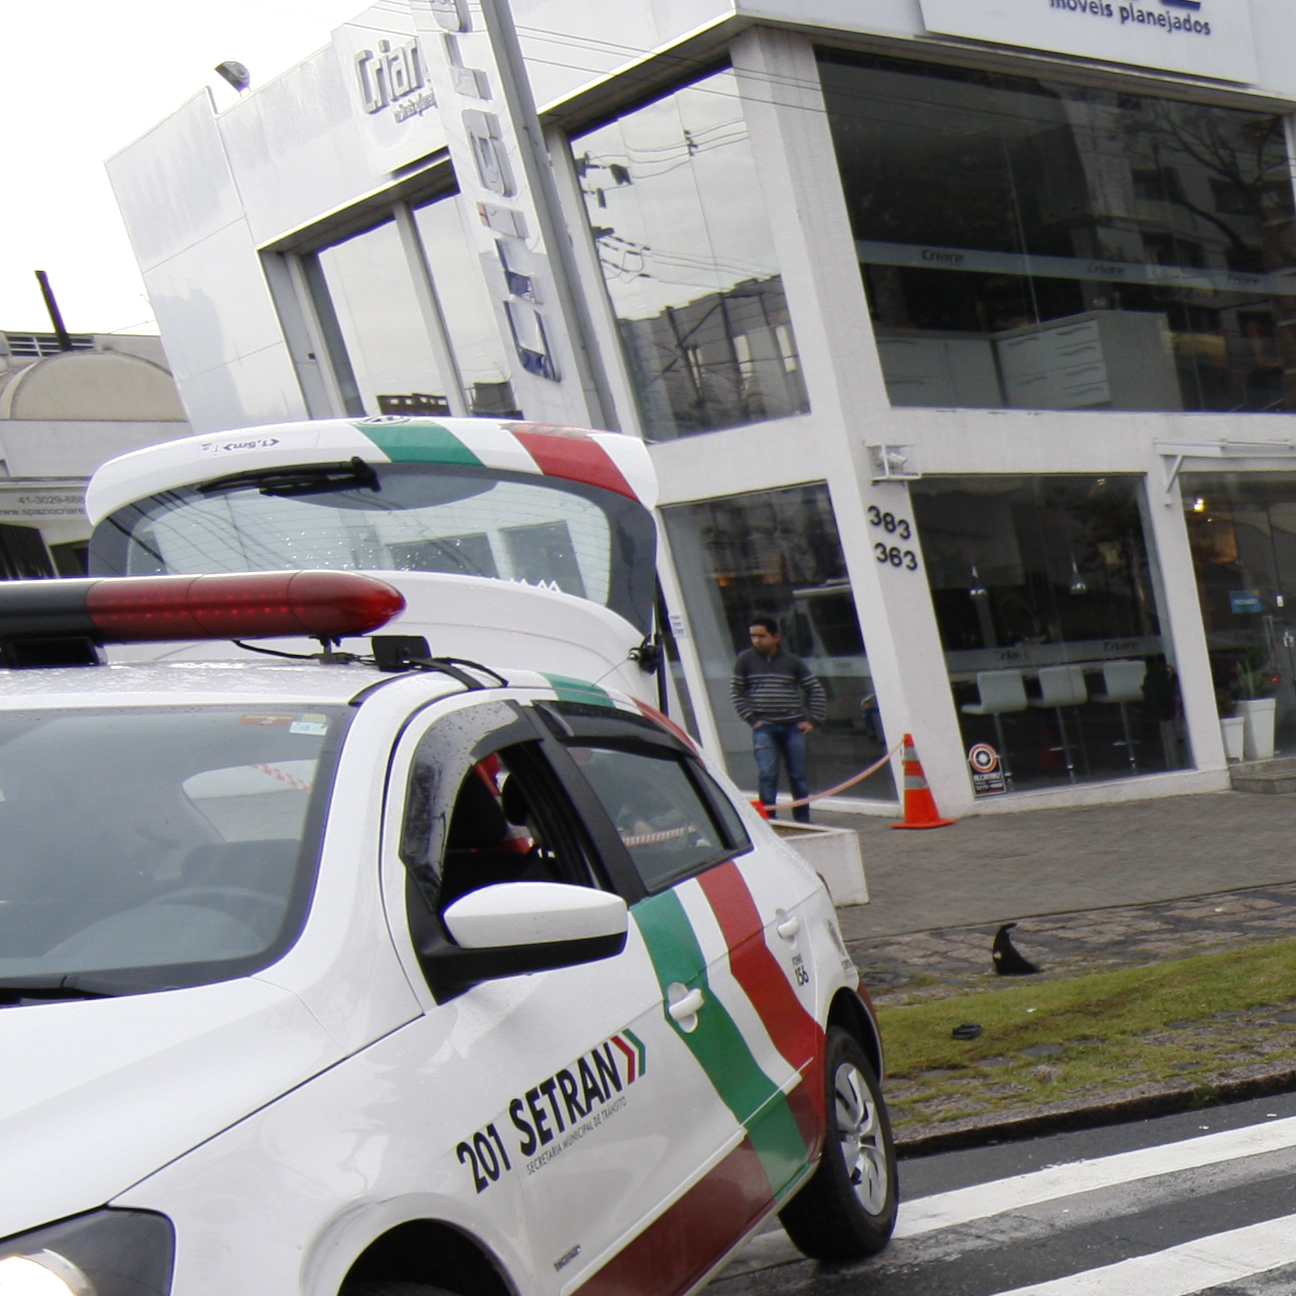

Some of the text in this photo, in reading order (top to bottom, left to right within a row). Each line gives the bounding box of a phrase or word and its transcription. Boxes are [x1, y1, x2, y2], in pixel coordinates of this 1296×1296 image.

[1119, 4, 1211, 36] planejados
[353, 38, 426, 115] Criar
[922, 248, 964, 264] Criare
[867, 505, 911, 540] 383
[874, 542, 918, 571] 363
[794, 964, 810, 987] 156
[455, 1041, 624, 1194] 201 SETRAN
[526, 1143, 562, 1176] SECRETARIA
[561, 1120, 594, 1148] MUNICIPAL
[592, 1112, 602, 1127] DE
